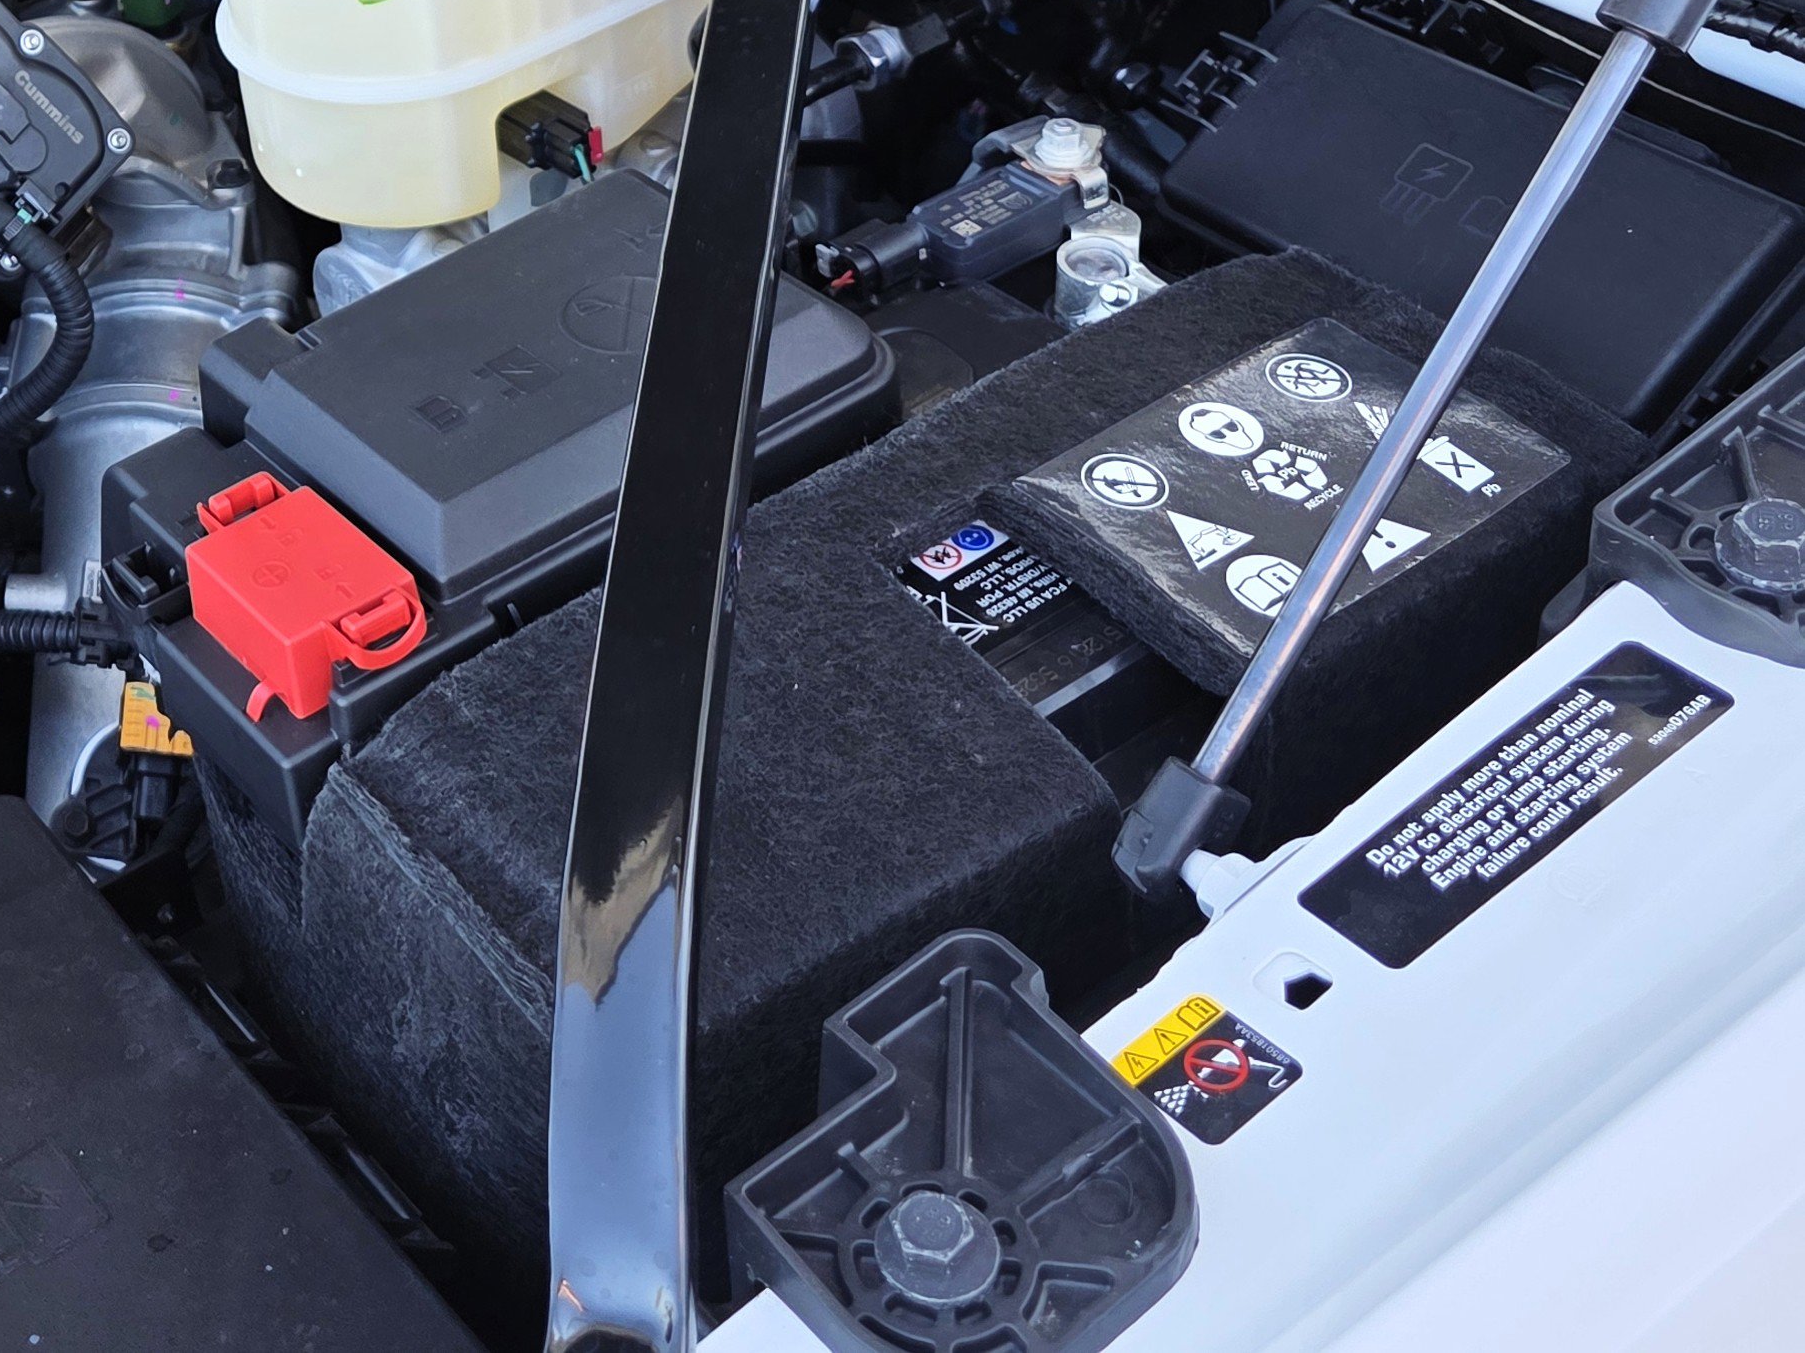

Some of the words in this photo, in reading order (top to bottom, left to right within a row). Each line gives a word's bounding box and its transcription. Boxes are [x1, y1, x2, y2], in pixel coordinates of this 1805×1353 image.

[13, 69, 85, 145] Cummins
[1280, 441, 1327, 461] RETURN
[1277, 466, 1298, 481] Pb
[1304, 483, 1344, 511] RECYCLE
[1481, 482, 1502, 497] Pb
[980, 573, 1005, 591] LLC
[1043, 582, 1068, 601] FCA
[975, 589, 1004, 608] POR
[1026, 595, 1045, 611] US
[1002, 607, 1029, 624] LLC
[1647, 692, 1713, 747] 53040076AB
[1366, 843, 1395, 867] Do
[1393, 821, 1424, 847] not
[1422, 789, 1466, 828] apply
[1461, 759, 1503, 793] more
[1498, 732, 1539, 765] than
[1536, 688, 1595, 737] nominal
[1383, 847, 1421, 877] 12V
[1418, 830, 1441, 851] to
[1439, 776, 1514, 835] electrical
[1508, 736, 1566, 782] system
[1561, 697, 1617, 740] during
[1421, 816, 1493, 874] charging
[1485, 803, 1507, 824] or
[1502, 773, 1546, 811] jump
[1542, 726, 1612, 778] starting.
[1430, 843, 1488, 892] Engine
[1485, 819, 1519, 849] and
[1514, 772, 1581, 825] starting
[1576, 730, 1634, 779] system
[1475, 834, 1532, 880] failure
[1528, 803, 1574, 840] could
[1568, 766, 1625, 810] result.
[1235, 1022, 1291, 1064] 68501853AA
